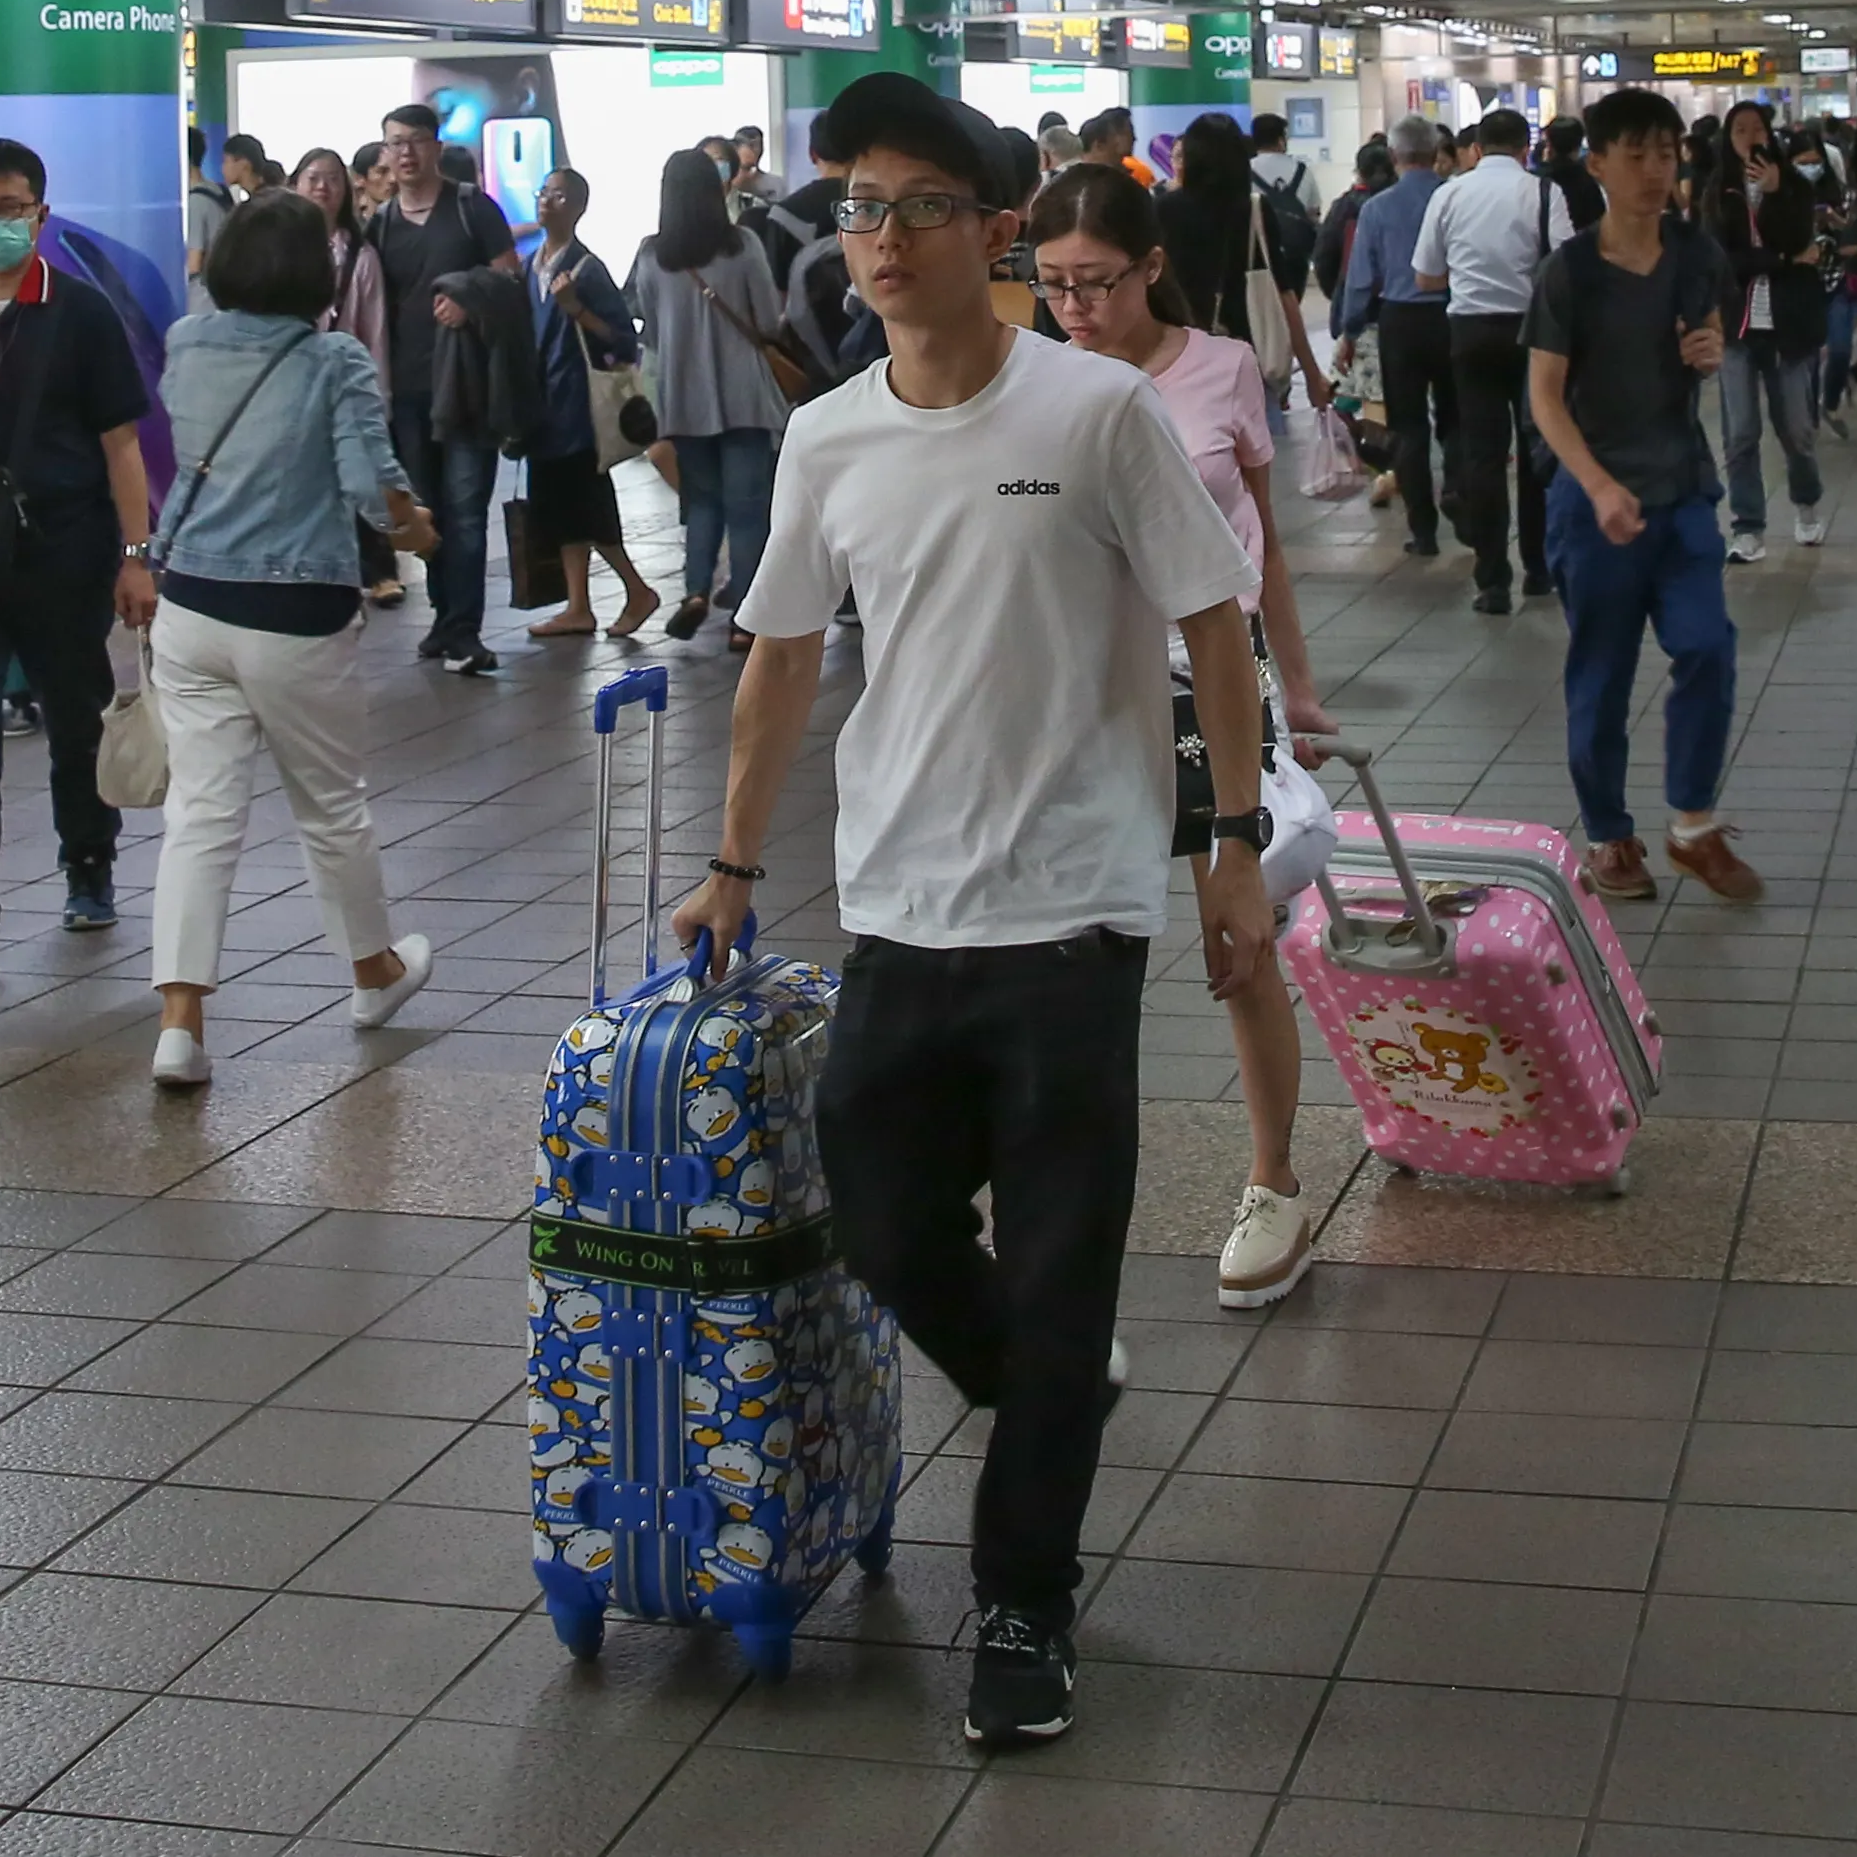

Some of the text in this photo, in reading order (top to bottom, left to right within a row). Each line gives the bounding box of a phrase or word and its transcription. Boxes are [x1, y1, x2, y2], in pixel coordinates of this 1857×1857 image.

[40, 3, 176, 33] Camera Phone
[997, 478, 1061, 496] adidas
[574, 1238, 633, 1268] WING
[640, 1250, 674, 1273] ON
[706, 1478, 750, 1499] PEKKLE
[544, 1508, 576, 1521] PEKKL
